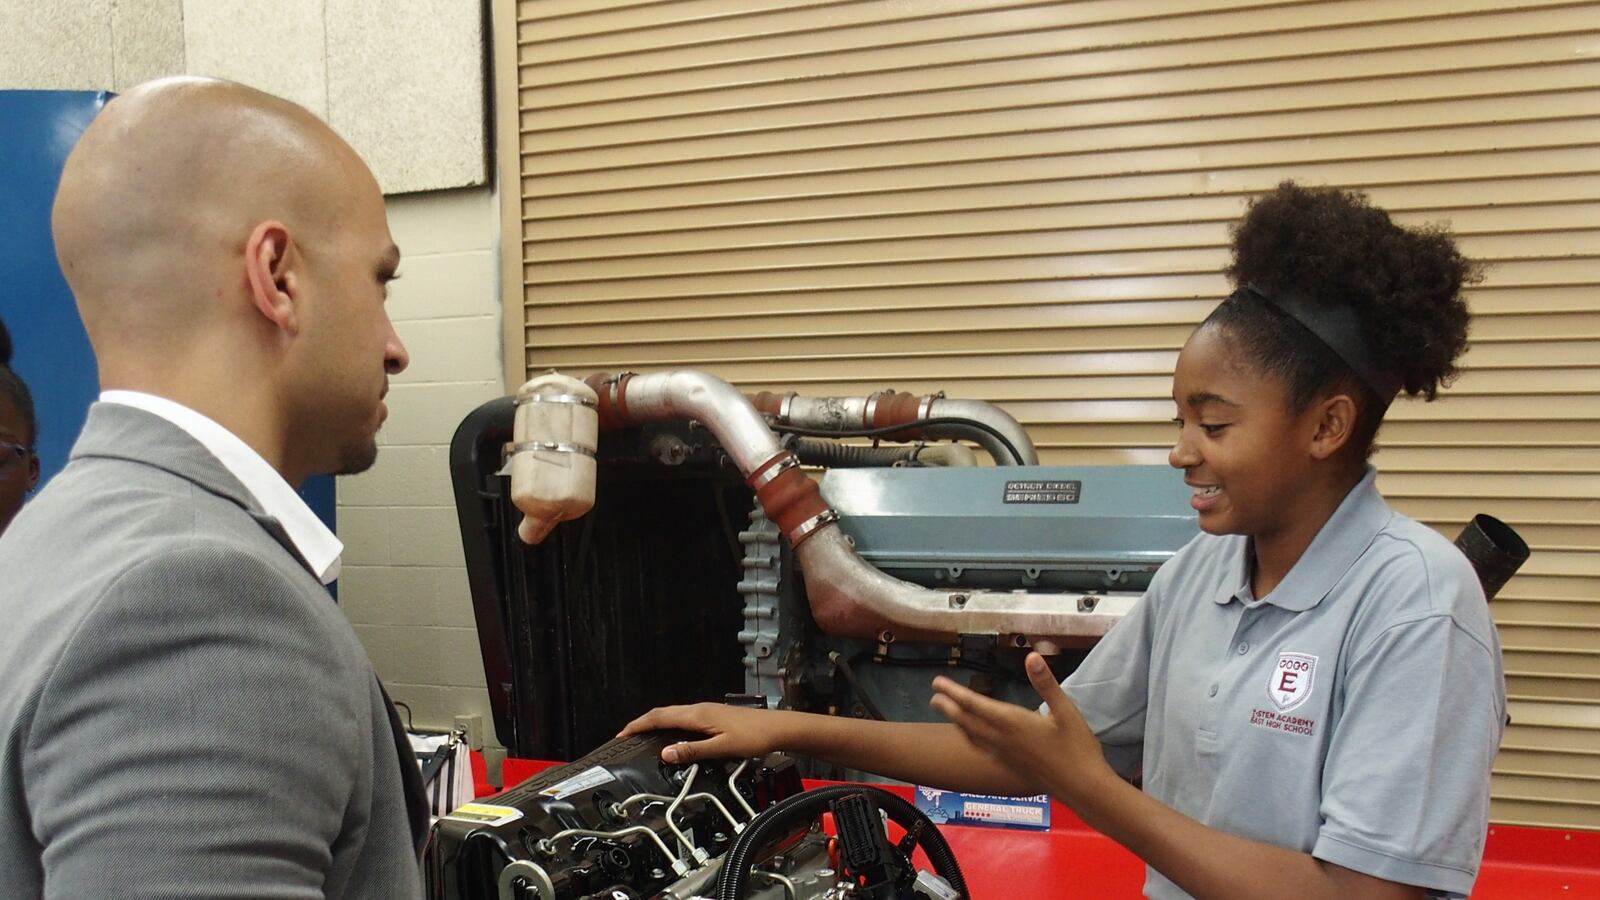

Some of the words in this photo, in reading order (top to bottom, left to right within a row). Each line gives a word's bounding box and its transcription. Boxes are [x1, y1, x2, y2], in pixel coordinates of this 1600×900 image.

[1277, 670, 1298, 693] E
[1250, 716, 1265, 725] EAST
[1266, 720, 1281, 729] HIGH
[1284, 723, 1314, 737] SCHOOL
[1276, 714, 1315, 728] ACADEMY
[966, 803, 1007, 813] GENERAL
[1010, 806, 1041, 816] TRUCK
